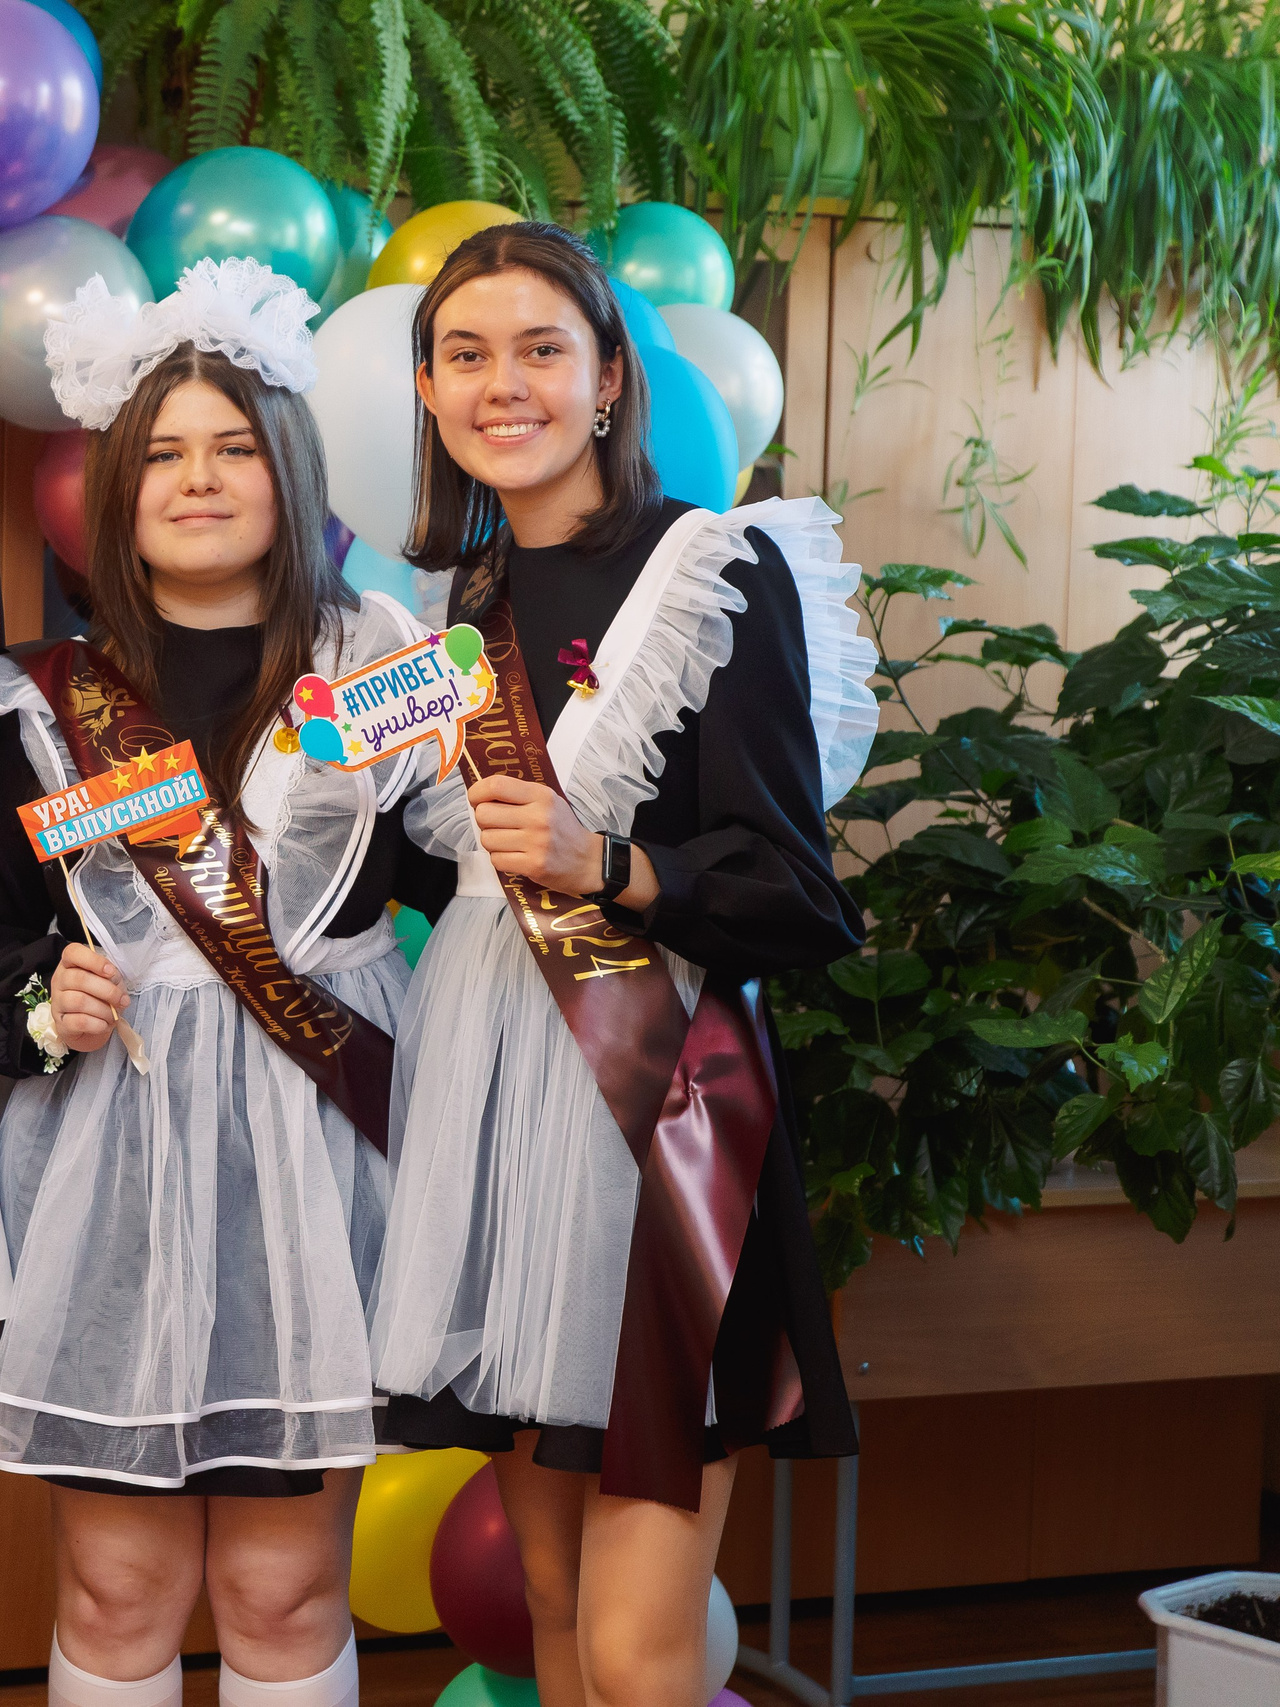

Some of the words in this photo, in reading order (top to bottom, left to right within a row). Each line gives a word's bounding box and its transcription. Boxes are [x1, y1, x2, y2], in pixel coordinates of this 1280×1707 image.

[342, 650, 455, 718] #ПРИВЕТ,
[361, 678, 463, 752] универ!
[506, 671, 529, 738] Мельник
[32, 786, 93, 829] УРА!
[43, 774, 201, 854] ВЫПУСКНОЙ!
[231, 847, 265, 898] Алиса
[154, 866, 186, 916] Школа
[184, 917, 218, 954] №422
[224, 965, 291, 1042] Кронштадт
